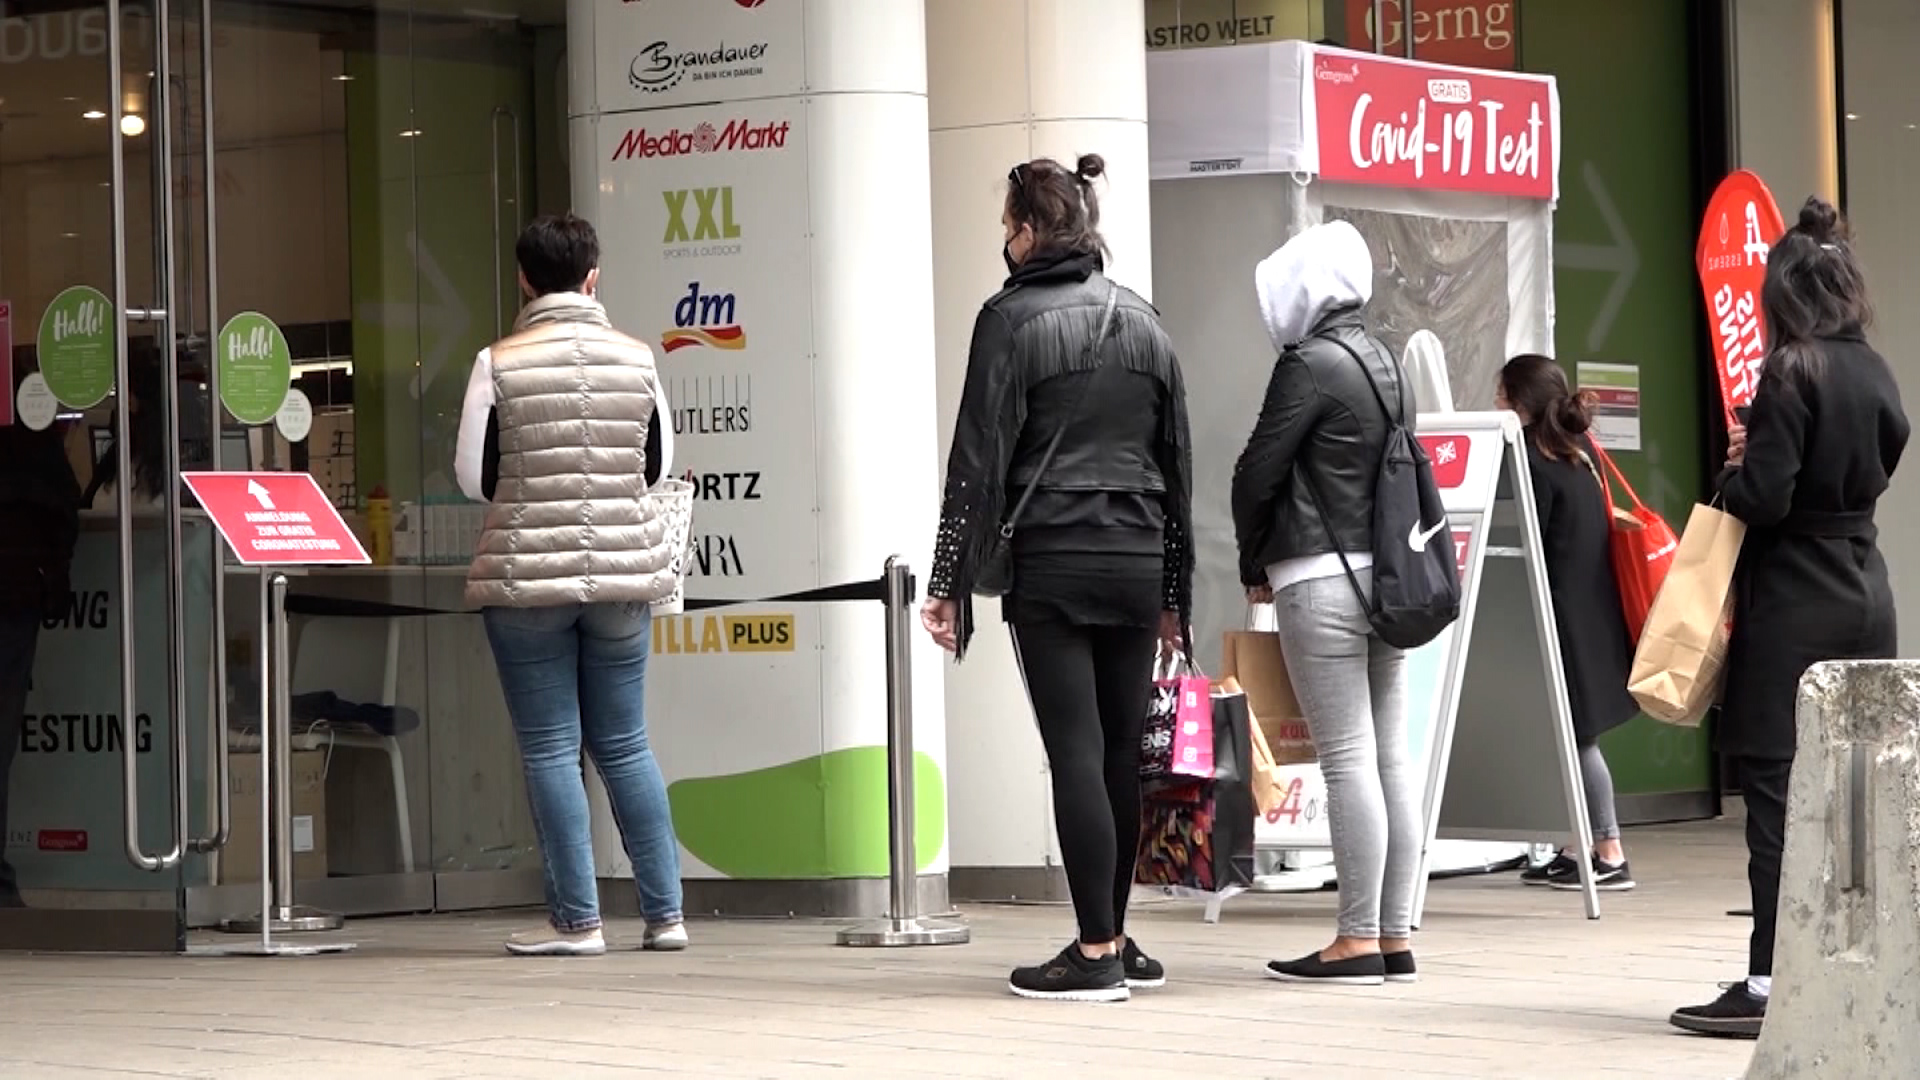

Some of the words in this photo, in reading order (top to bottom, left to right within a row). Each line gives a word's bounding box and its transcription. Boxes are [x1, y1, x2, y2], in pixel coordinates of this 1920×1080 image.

[1217, 15, 1274, 40] WELT
[1364, 0, 1512, 50] Gerng
[640, 40, 769, 73] Brandauer
[1431, 82, 1468, 100] GRATIS
[612, 128, 694, 162] Media
[713, 118, 790, 152] Markt
[1350, 94, 1473, 179] Covid-19
[1478, 100, 1543, 180] Test
[662, 186, 741, 244] XXL
[53, 299, 104, 342] Hallo!
[675, 281, 736, 328] dm
[228, 326, 273, 361] Hallo!
[672, 405, 750, 435] UTLERS
[244, 511, 311, 522] ANMELDUNG
[255, 525, 279, 536] ZUR
[277, 525, 316, 536] GRATIS
[251, 539, 340, 550] CORONATESTUNG
[686, 535, 743, 576] ARA
[41, 589, 109, 631] NG
[653, 613, 722, 655] ILLA
[733, 622, 789, 645] PLUS
[20, 712, 152, 753] ESTUNG
